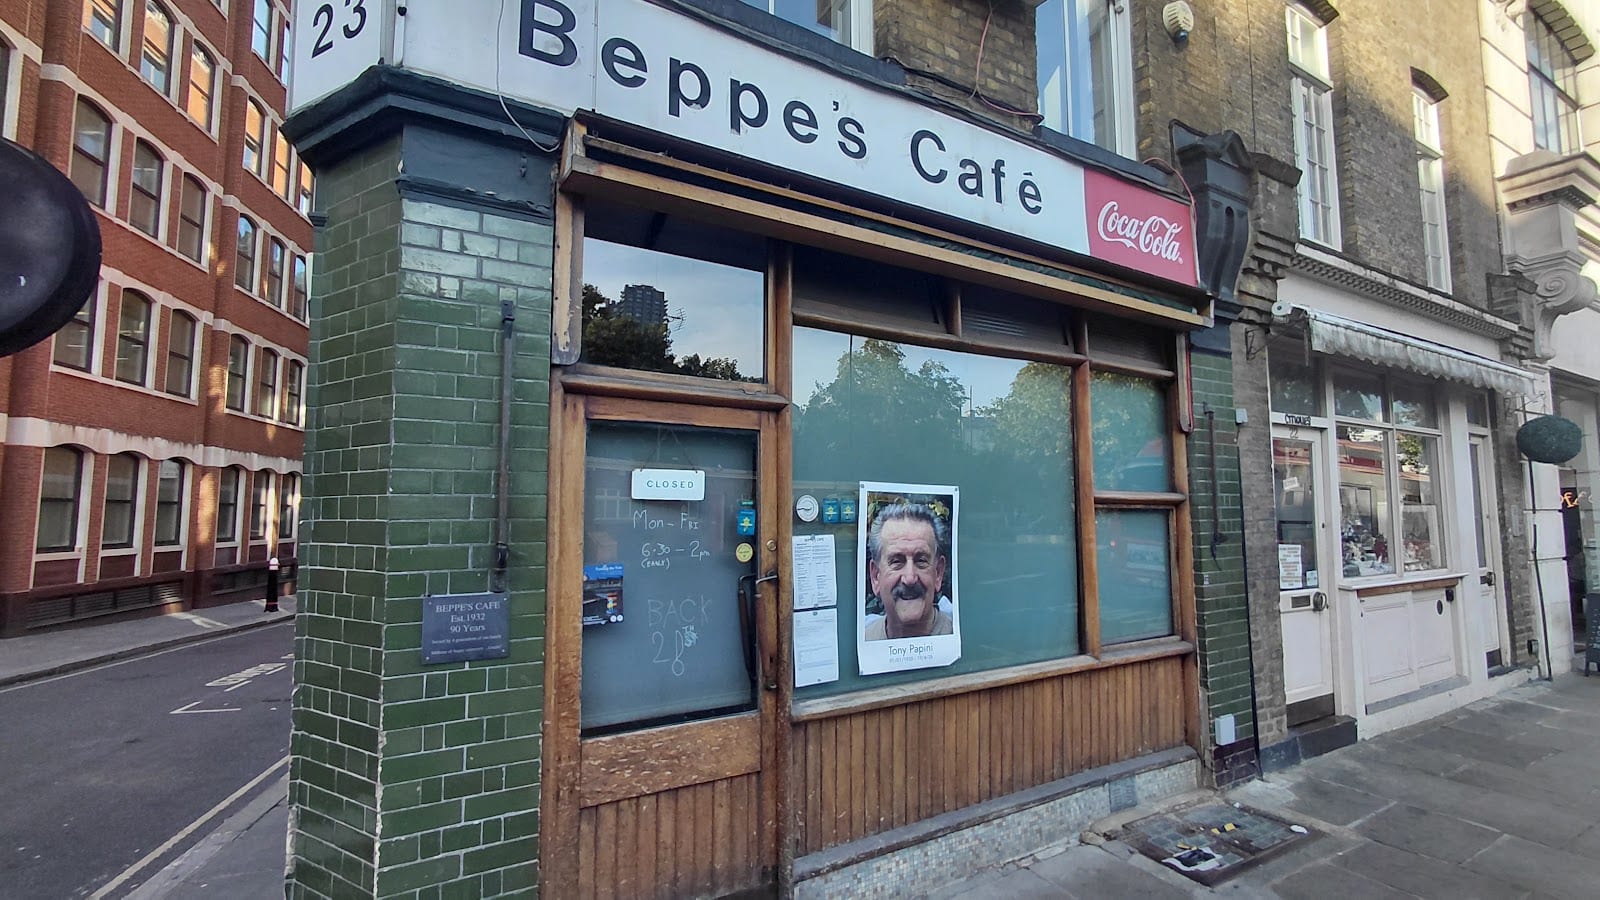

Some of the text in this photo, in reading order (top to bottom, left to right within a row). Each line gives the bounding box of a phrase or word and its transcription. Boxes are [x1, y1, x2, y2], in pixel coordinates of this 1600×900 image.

[311, 0, 367, 59] 23
[518, 0, 1043, 216] Beppe's Café
[1097, 200, 1183, 262] Coca-Cola
[646, 480, 694, 489] CLOSED
[633, 509, 664, 530] Mon
[689, 540, 711, 561] 2pm
[647, 594, 712, 629] BACK
[450, 625, 461, 633] 90
[888, 643, 934, 657] Tony Papini
